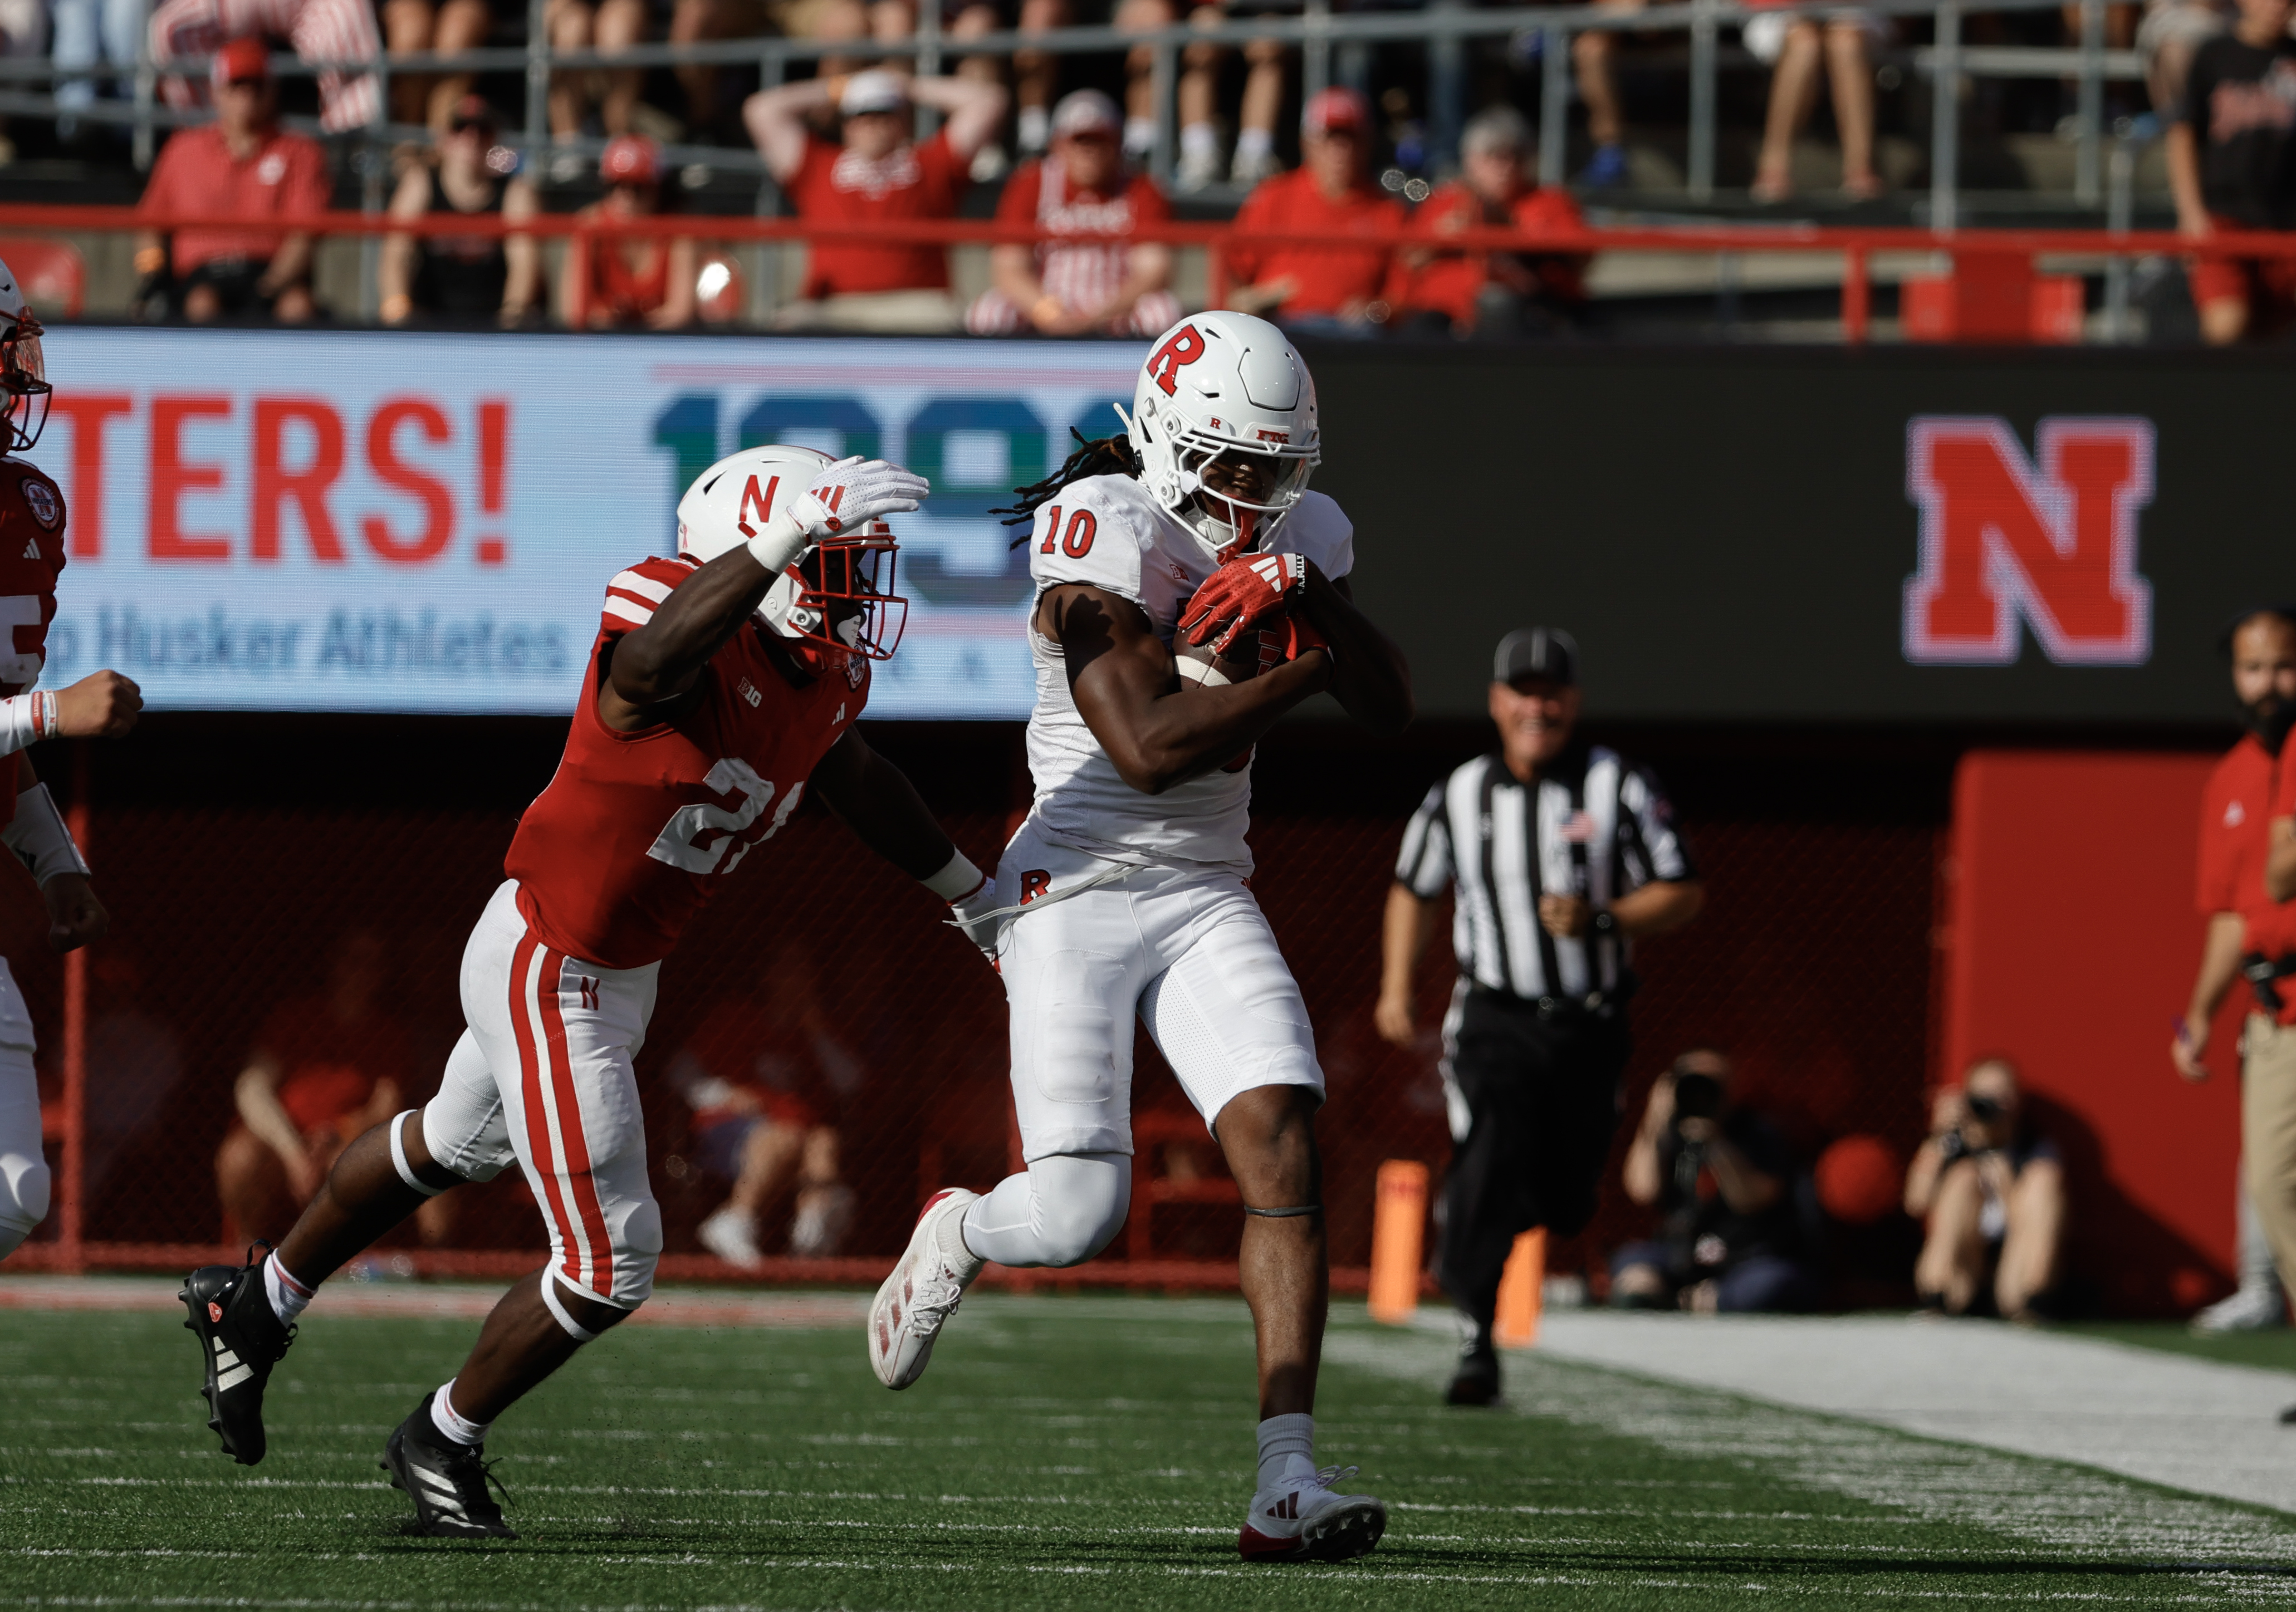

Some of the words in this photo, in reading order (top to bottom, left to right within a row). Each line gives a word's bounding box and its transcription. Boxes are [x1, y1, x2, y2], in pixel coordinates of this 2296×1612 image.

[1146, 322, 1205, 398] R
[1210, 417, 1221, 429] R
[11, 391, 513, 569] TERS!
[738, 474, 781, 523] N
[1040, 505, 1097, 559] 10
[1901, 413, 2157, 667] N
[96, 601, 307, 670] Husker
[319, 601, 570, 671] Athletes
[645, 757, 804, 875] 2
[1019, 869, 1051, 907] R
